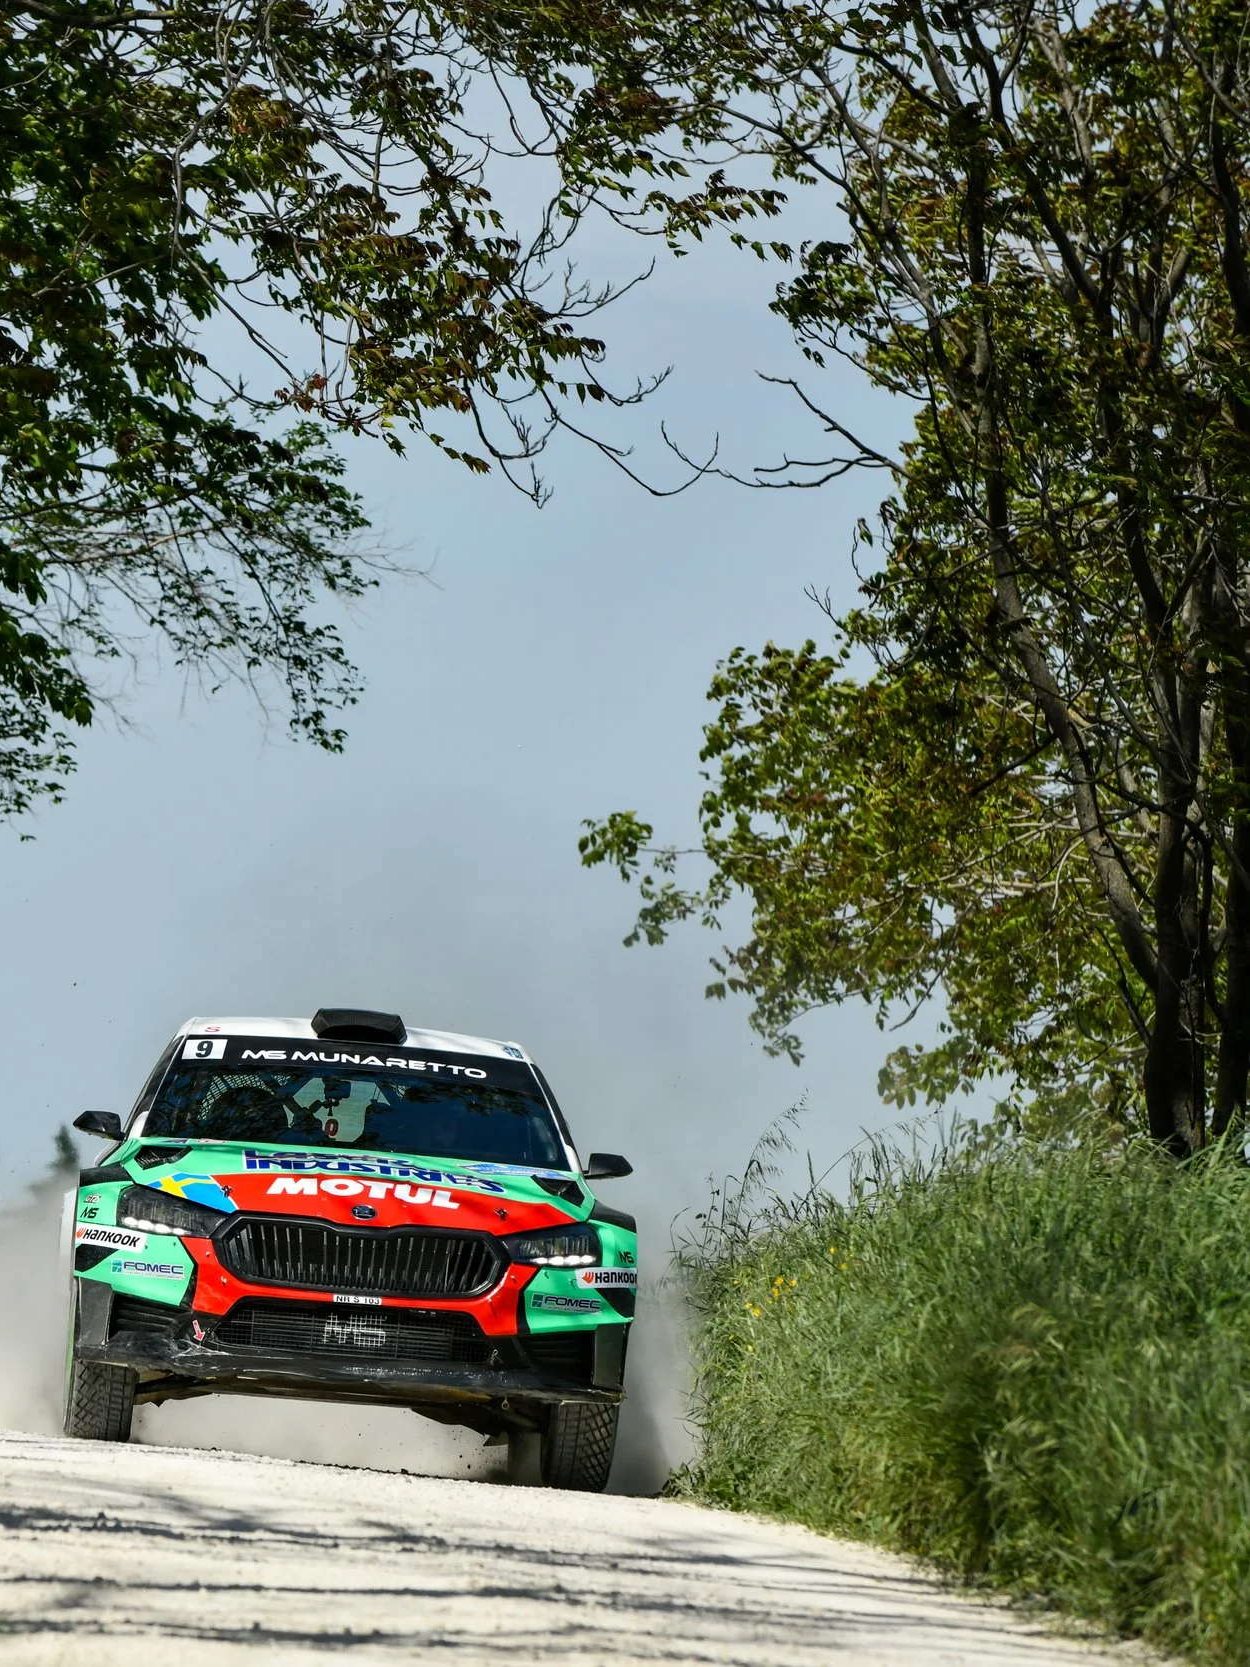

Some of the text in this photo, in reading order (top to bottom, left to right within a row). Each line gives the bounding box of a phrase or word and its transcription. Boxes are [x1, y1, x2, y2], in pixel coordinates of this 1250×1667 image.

[195, 1040, 214, 1058] 9
[241, 1049, 288, 1060] MS
[291, 1050, 487, 1079] MUNARETTO
[266, 1177, 460, 1210] MOTUL
[80, 1206, 100, 1219] MS
[82, 1228, 141, 1248] HANKOOK
[123, 1261, 184, 1275] FOMEC
[544, 1296, 601, 1310] FOMEC
